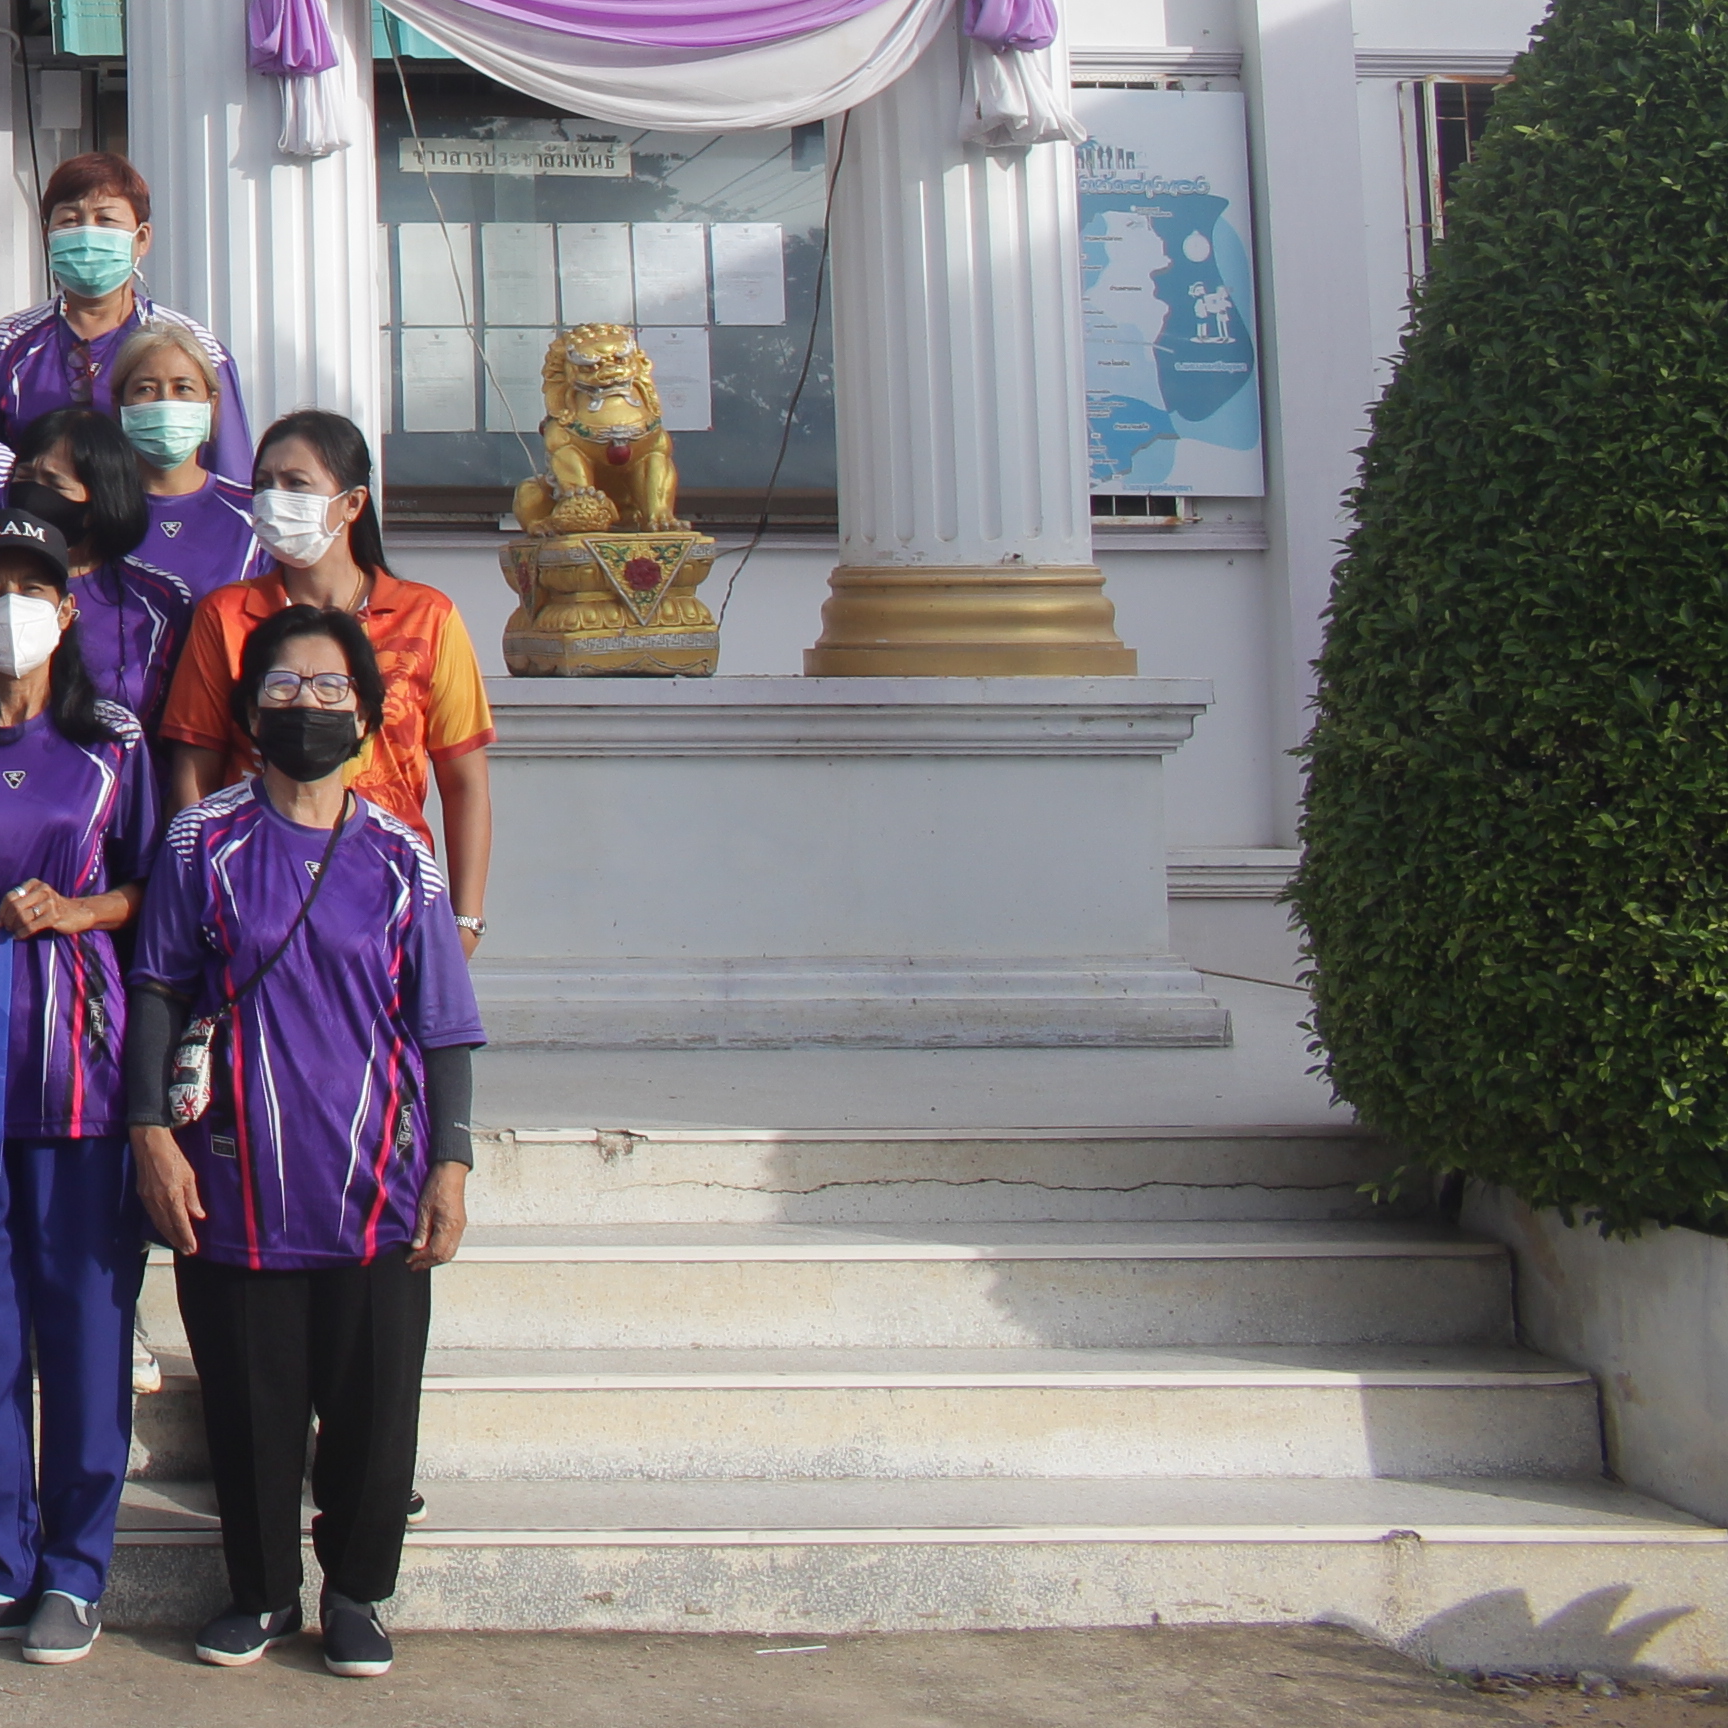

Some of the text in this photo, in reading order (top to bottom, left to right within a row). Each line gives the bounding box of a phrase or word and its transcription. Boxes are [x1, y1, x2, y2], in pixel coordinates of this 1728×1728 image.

[413, 141, 615, 169] ข่าวสารประชาสัมพันธ์
